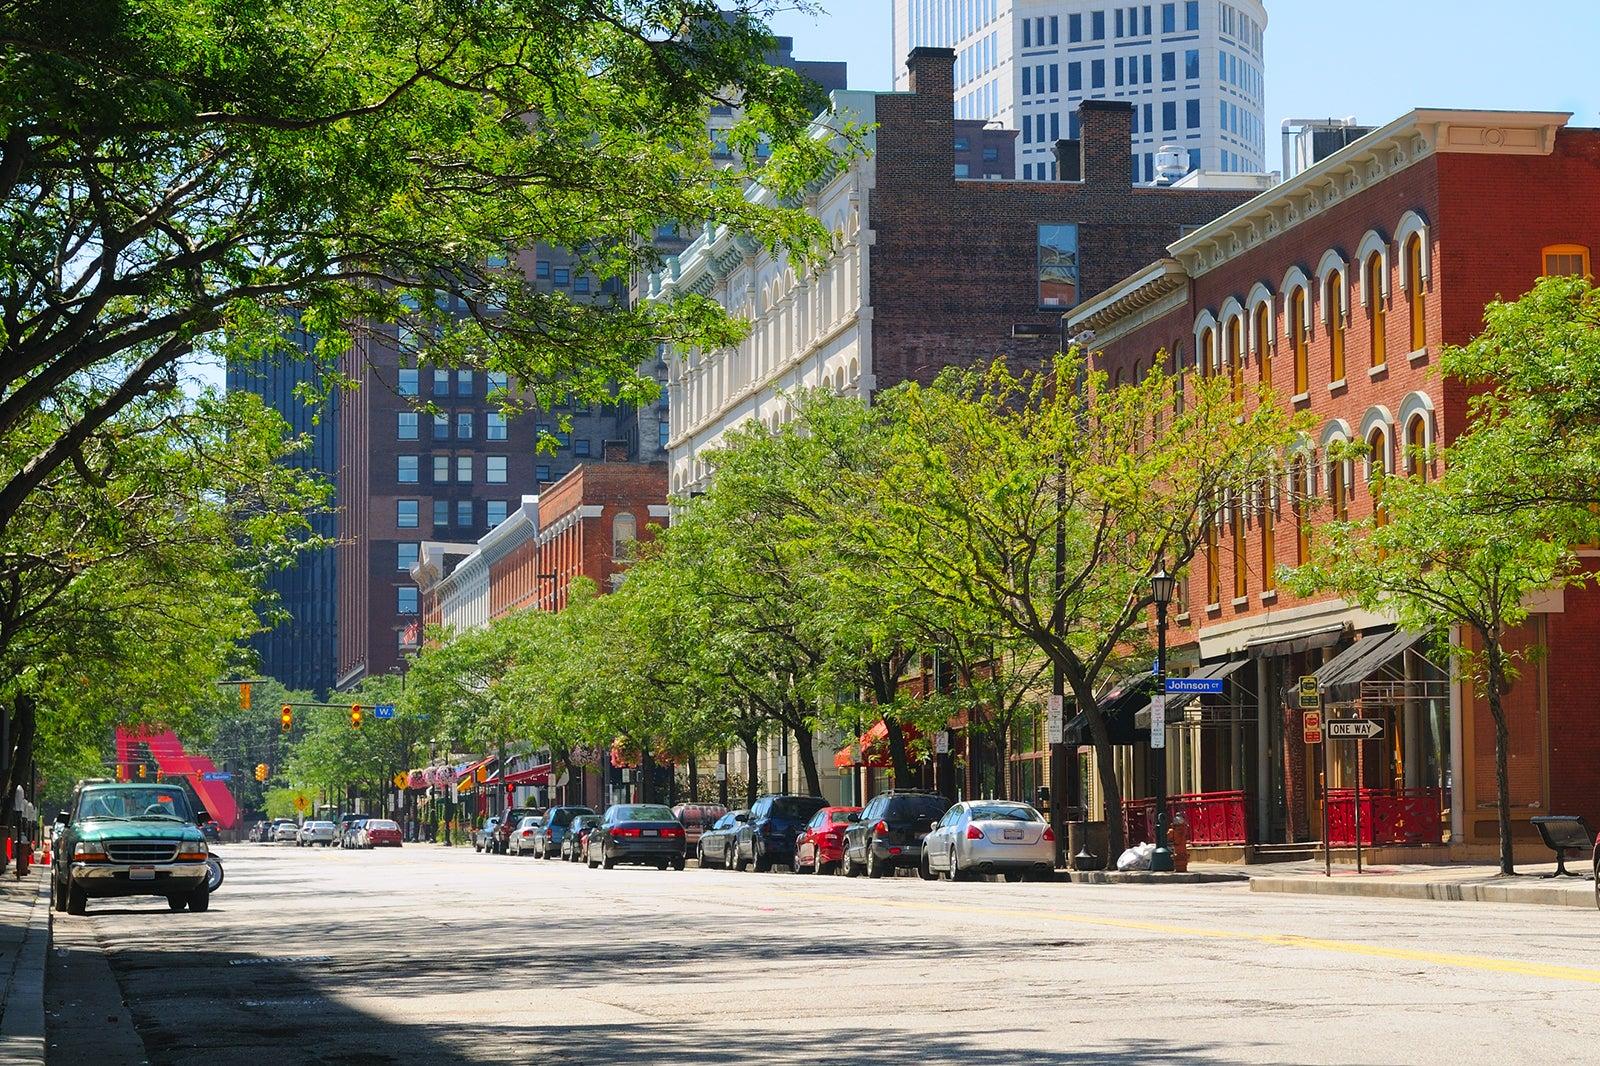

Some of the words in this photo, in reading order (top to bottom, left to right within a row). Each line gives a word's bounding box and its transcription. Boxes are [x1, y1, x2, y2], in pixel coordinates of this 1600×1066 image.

[1169, 681, 1210, 690] Johnson
[379, 708, 391, 716] W.
[1333, 724, 1351, 734] ONE
[1354, 724, 1372, 734] WAY
